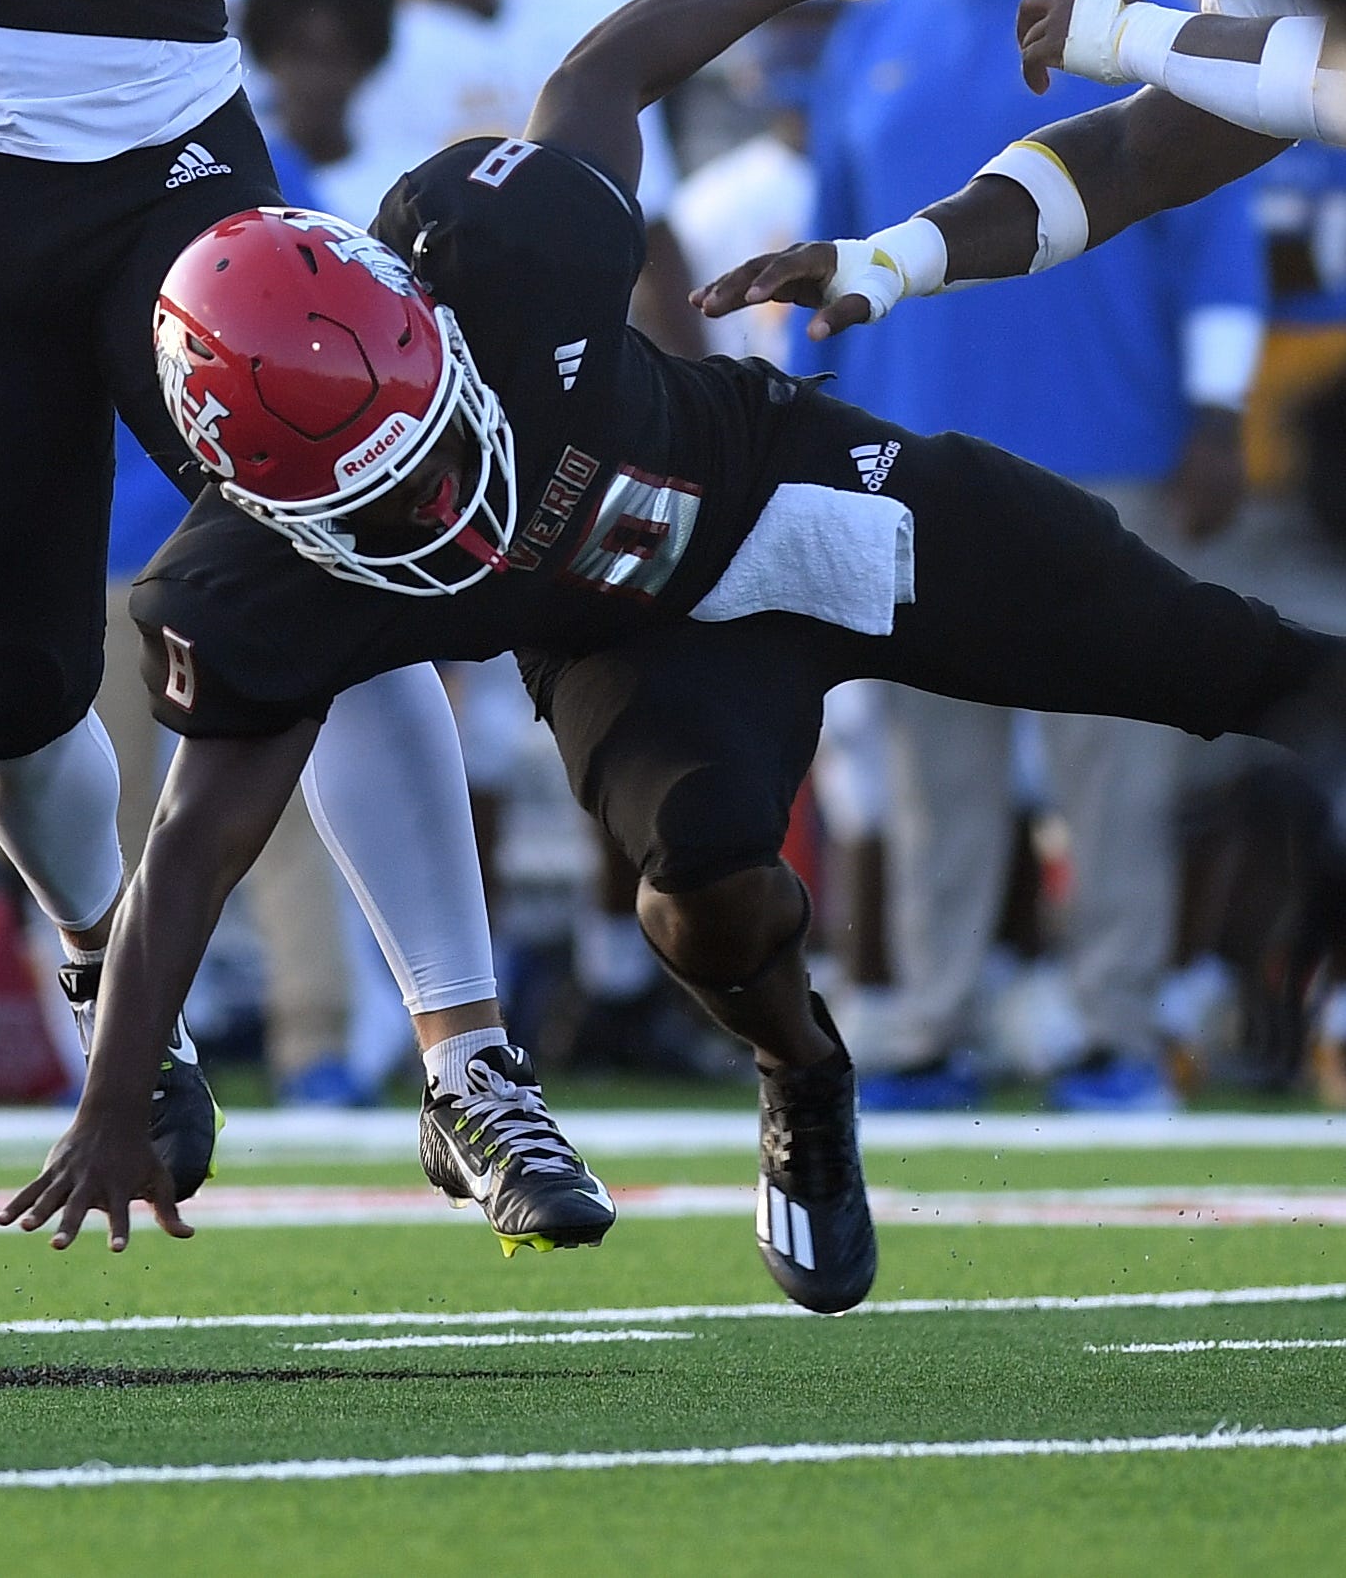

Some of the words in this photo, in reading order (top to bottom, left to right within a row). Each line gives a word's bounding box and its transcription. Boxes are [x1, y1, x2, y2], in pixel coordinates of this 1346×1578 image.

[165, 164, 233, 189] adidas
[467, 136, 544, 191] 8
[342, 420, 406, 477] Riddell
[867, 440, 902, 492] adidas
[507, 443, 601, 572] VERO
[160, 625, 200, 715] 8
